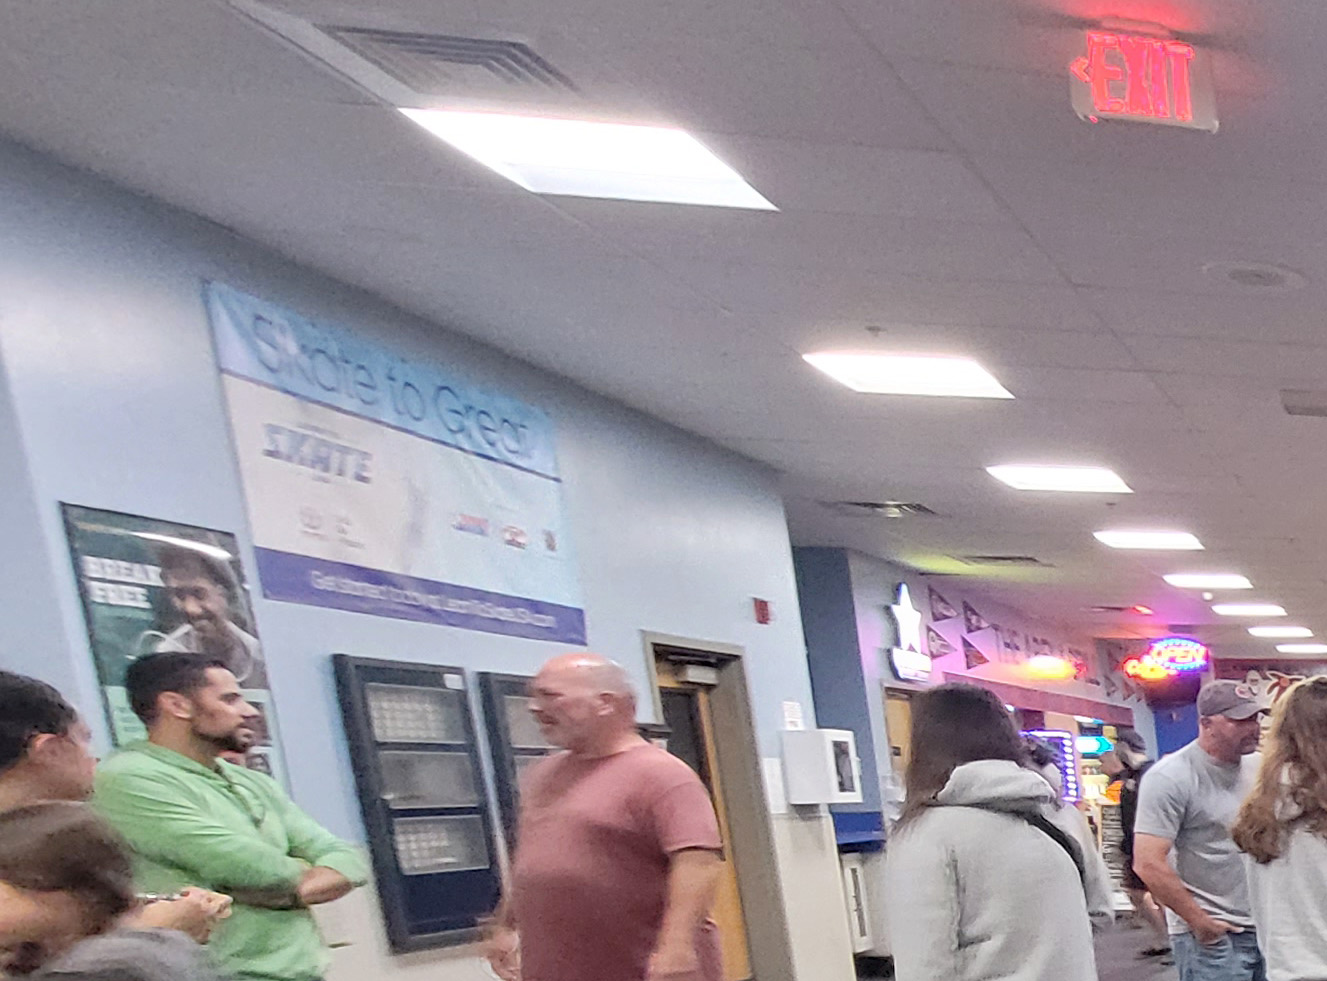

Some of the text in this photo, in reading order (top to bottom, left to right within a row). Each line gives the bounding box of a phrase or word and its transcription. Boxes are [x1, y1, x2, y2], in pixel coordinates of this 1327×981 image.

[1087, 31, 1195, 122] EXIT
[253, 312, 377, 406] Skate
[386, 365, 426, 422] to
[87, 580, 151, 609] FREE
